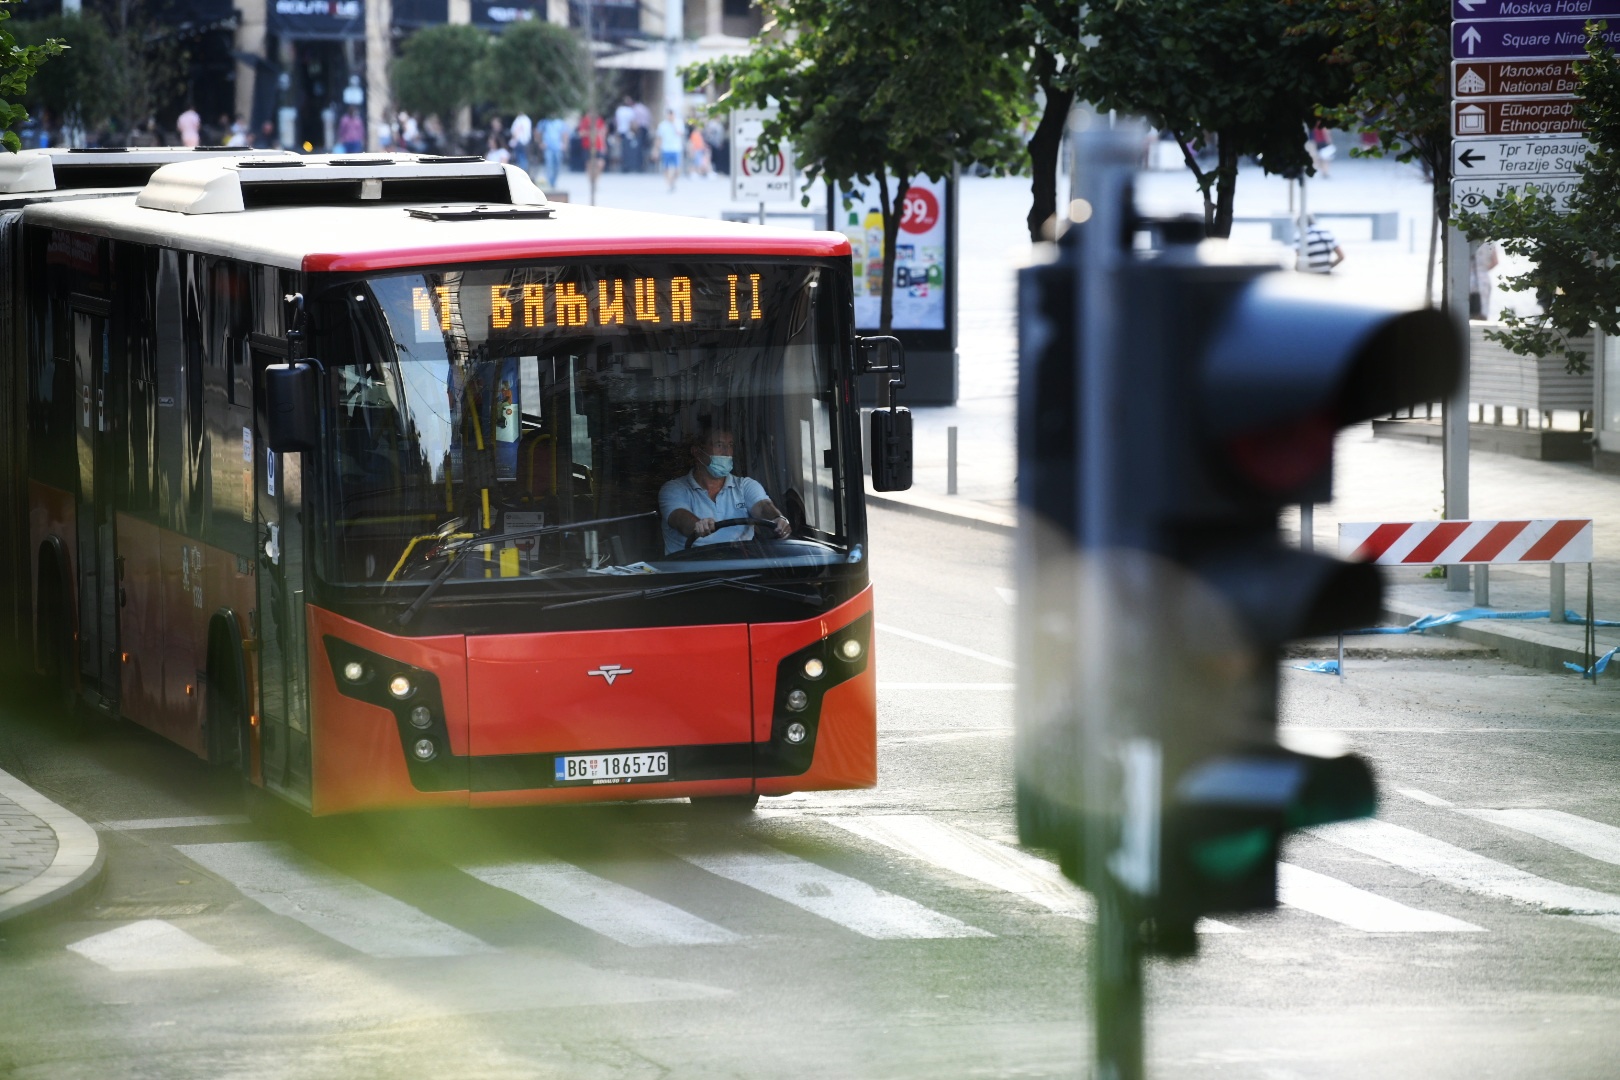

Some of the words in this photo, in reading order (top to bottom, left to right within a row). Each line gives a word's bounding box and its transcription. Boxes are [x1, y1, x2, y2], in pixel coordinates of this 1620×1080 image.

[1499, 2, 1552, 14] Moskva
[1555, 0, 1592, 13] Hotel
[1501, 33, 1551, 48] Square
[1554, 31, 1586, 44] Nine
[1499, 64, 1561, 77] Изложба
[1499, 80, 1553, 93] National
[1556, 79, 1582, 91] Ban
[1500, 102, 1573, 117] Етнограф
[1499, 144, 1521, 158] Трг
[1526, 142, 1587, 157] Теразије
[1499, 159, 1550, 174] Terazije
[491, 276, 692, 329] БАЊИЦА
[568, 759, 587, 777] BG
